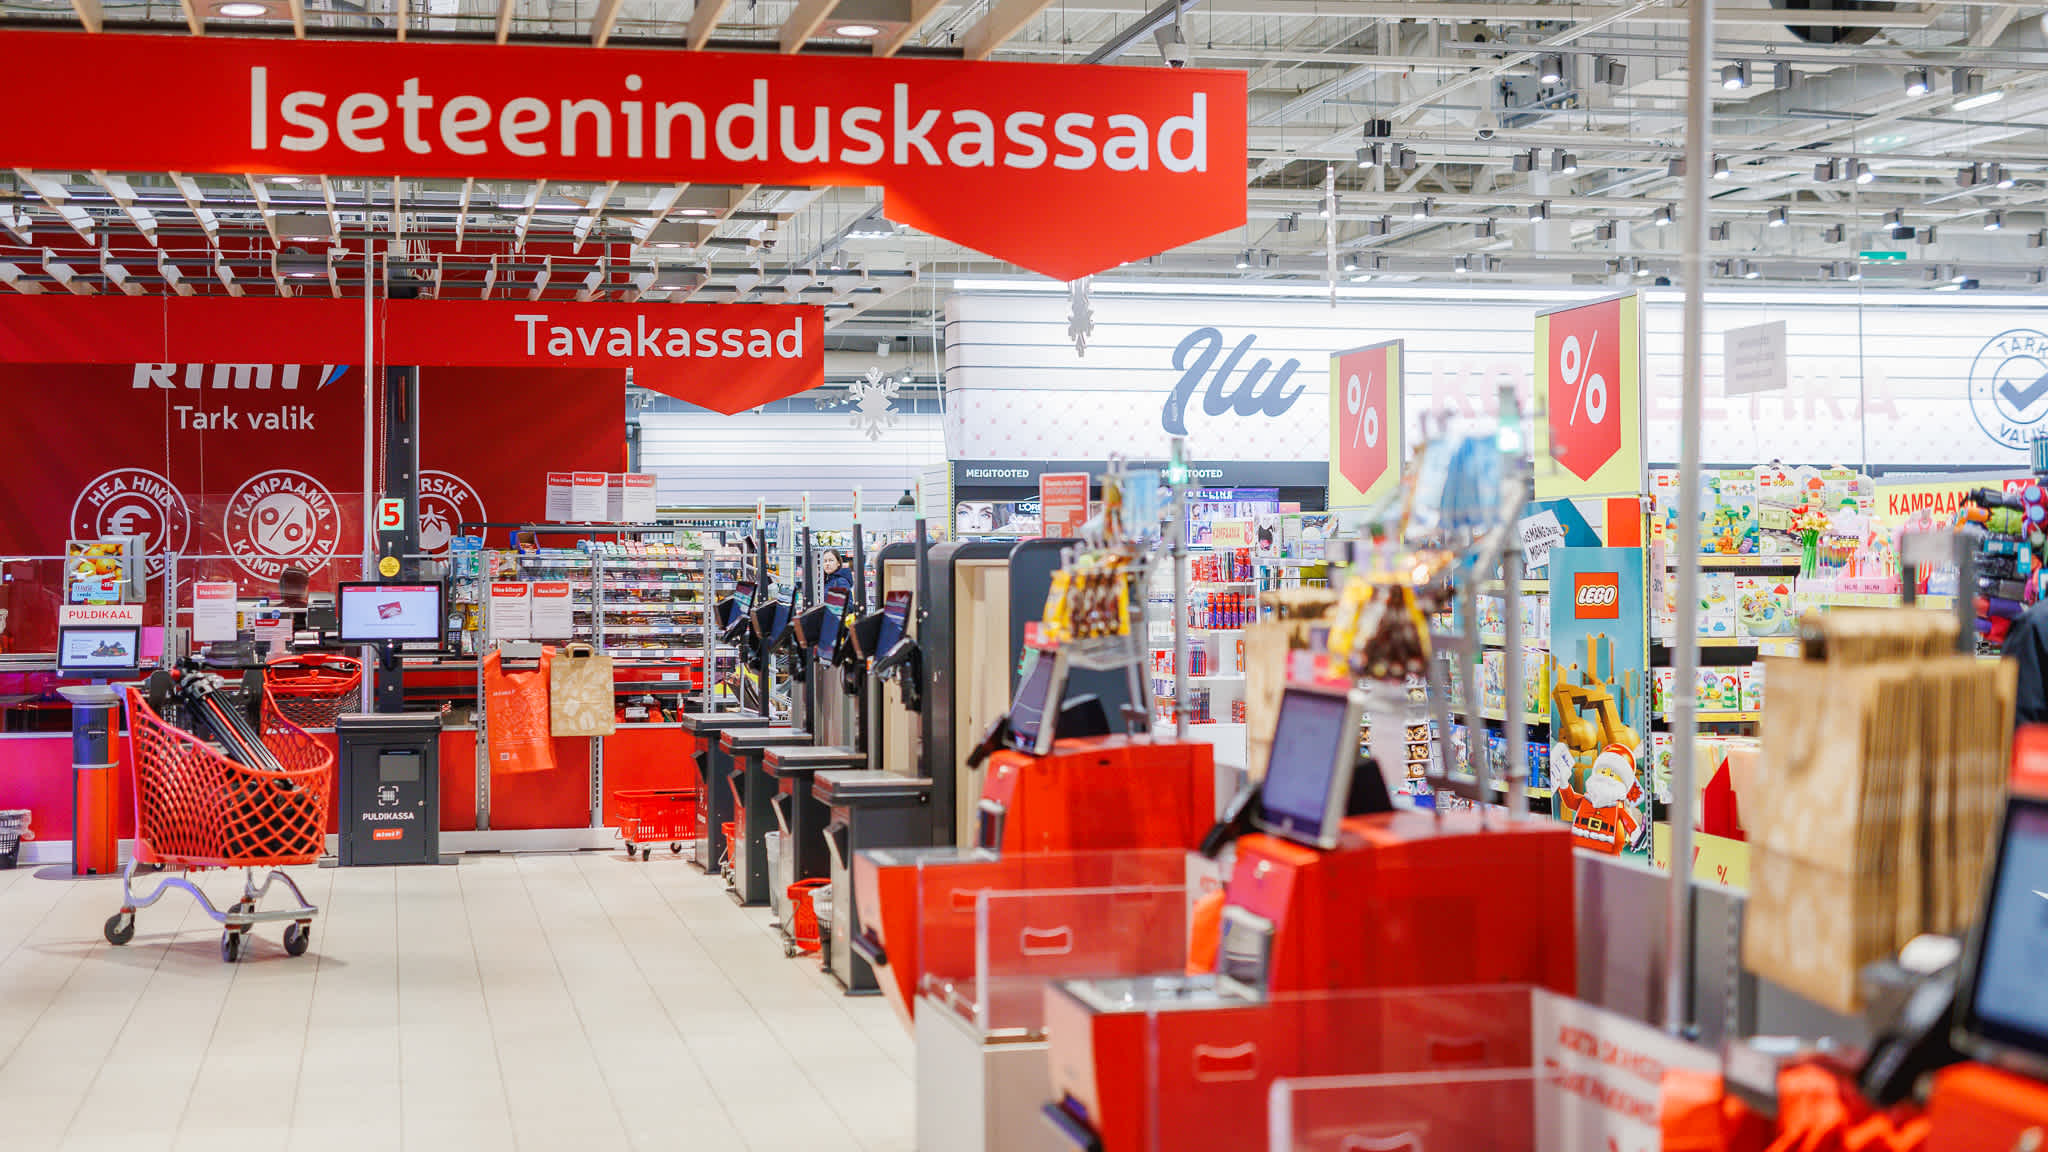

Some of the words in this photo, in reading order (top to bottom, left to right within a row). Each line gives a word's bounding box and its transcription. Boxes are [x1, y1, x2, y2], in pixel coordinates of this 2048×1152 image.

[250, 65, 1208, 173] Iseteeninduskassad
[514, 314, 803, 359] Tavakassad
[1161, 326, 1307, 436] Ilu
[173, 405, 239, 430] Tark
[247, 405, 315, 430] valik
[966, 469, 1029, 478] MEIGITOOTED
[87, 476, 128, 507] HEA
[131, 475, 173, 508] HIND
[232, 477, 327, 521] KAMPAANIA
[420, 478, 469, 505] RSKE
[383, 502, 401, 527] 5
[1576, 585, 1618, 606] LEGO
[68, 610, 134, 620] PULDIKAAL
[362, 812, 415, 821] PULDIKASSA
